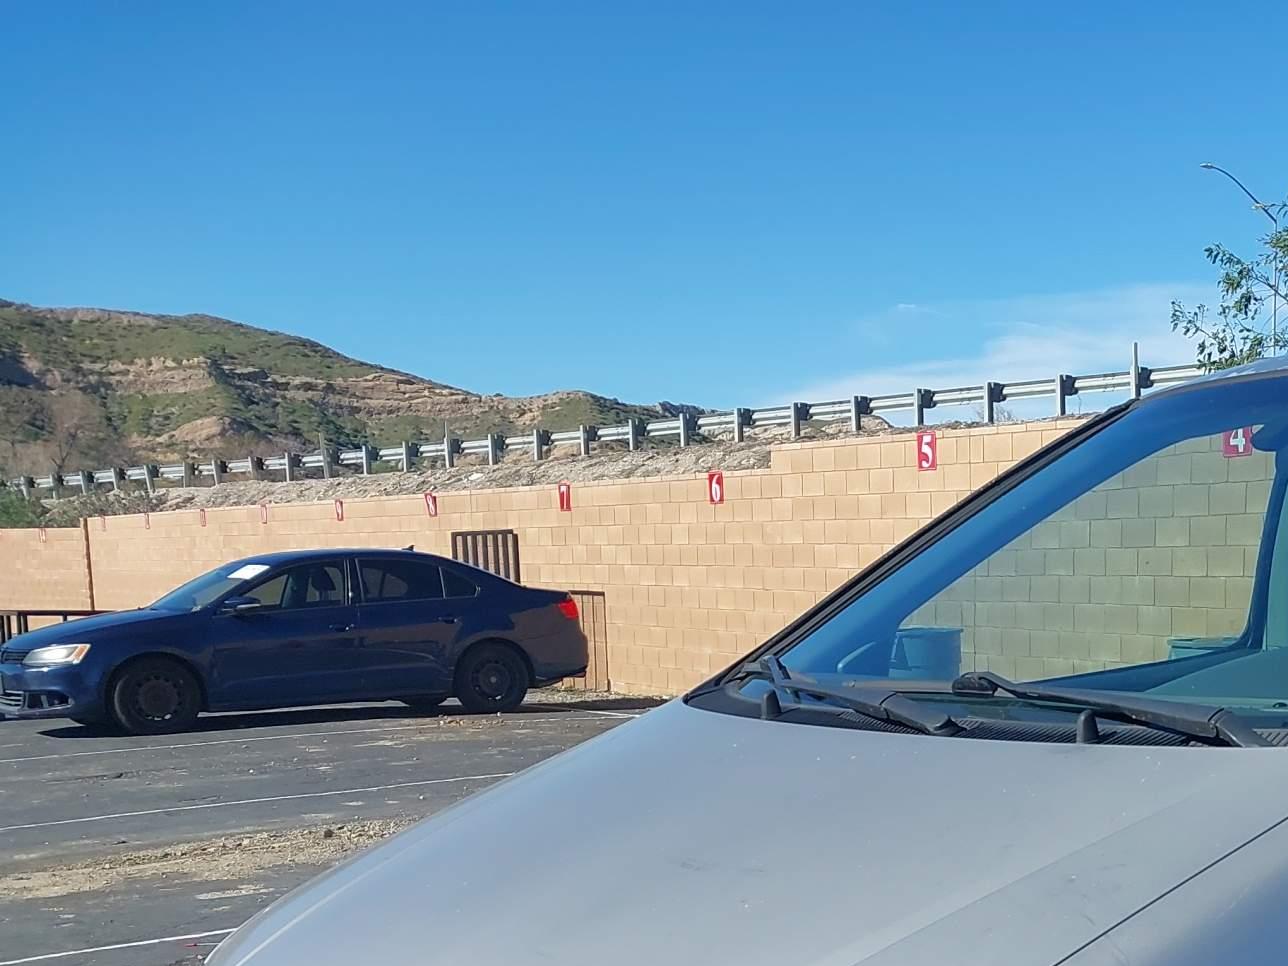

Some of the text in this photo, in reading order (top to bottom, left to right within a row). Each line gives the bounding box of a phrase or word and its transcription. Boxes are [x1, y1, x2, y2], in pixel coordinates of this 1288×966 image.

[921, 434, 933, 468] 5
[1229, 427, 1246, 453] 4
[559, 485, 568, 510] 7
[711, 474, 721, 502] 6
